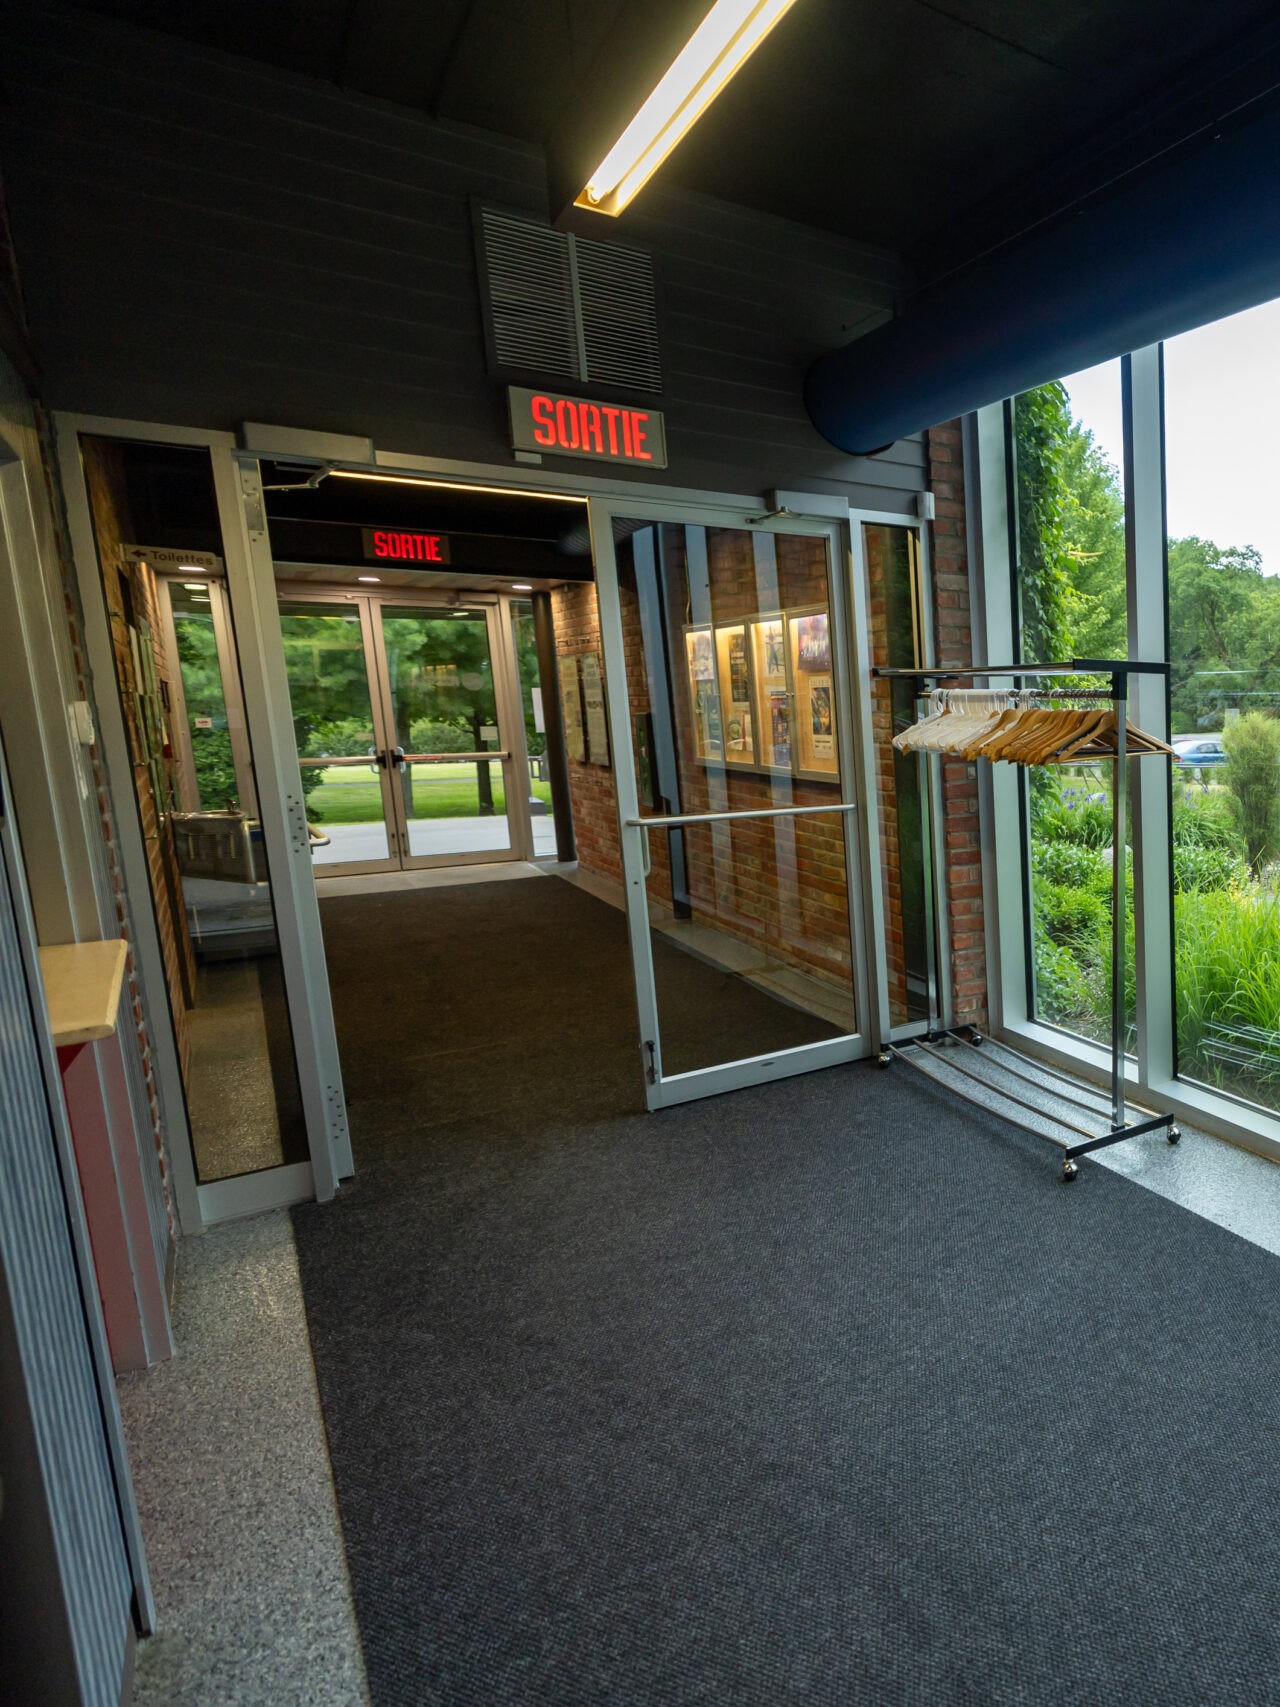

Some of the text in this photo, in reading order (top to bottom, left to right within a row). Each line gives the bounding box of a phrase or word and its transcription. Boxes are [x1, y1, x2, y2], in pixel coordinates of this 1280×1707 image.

[531, 395, 653, 460] SORTIE
[150, 550, 214, 566] Toilettes
[373, 531, 443, 561] SORTIE
